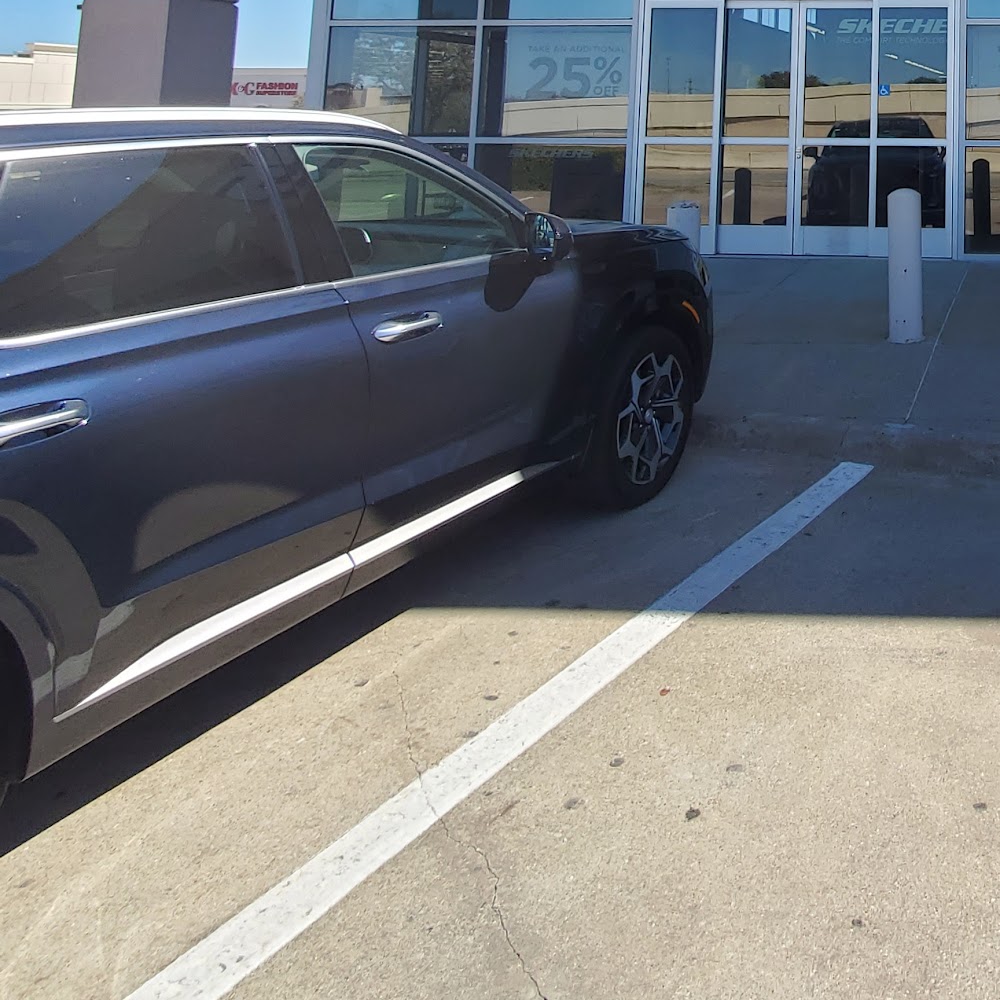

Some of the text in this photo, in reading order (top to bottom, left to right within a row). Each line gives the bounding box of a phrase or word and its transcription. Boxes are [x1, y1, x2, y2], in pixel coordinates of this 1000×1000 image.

[837, 18, 948, 34] SKECHE
[895, 36, 946, 44] TECHNOLOG
[528, 45, 624, 53] TAKE AN ADDITIONAL
[525, 56, 623, 99] 25%
[256, 82, 298, 90] FASHION
[593, 85, 620, 97] OFF
